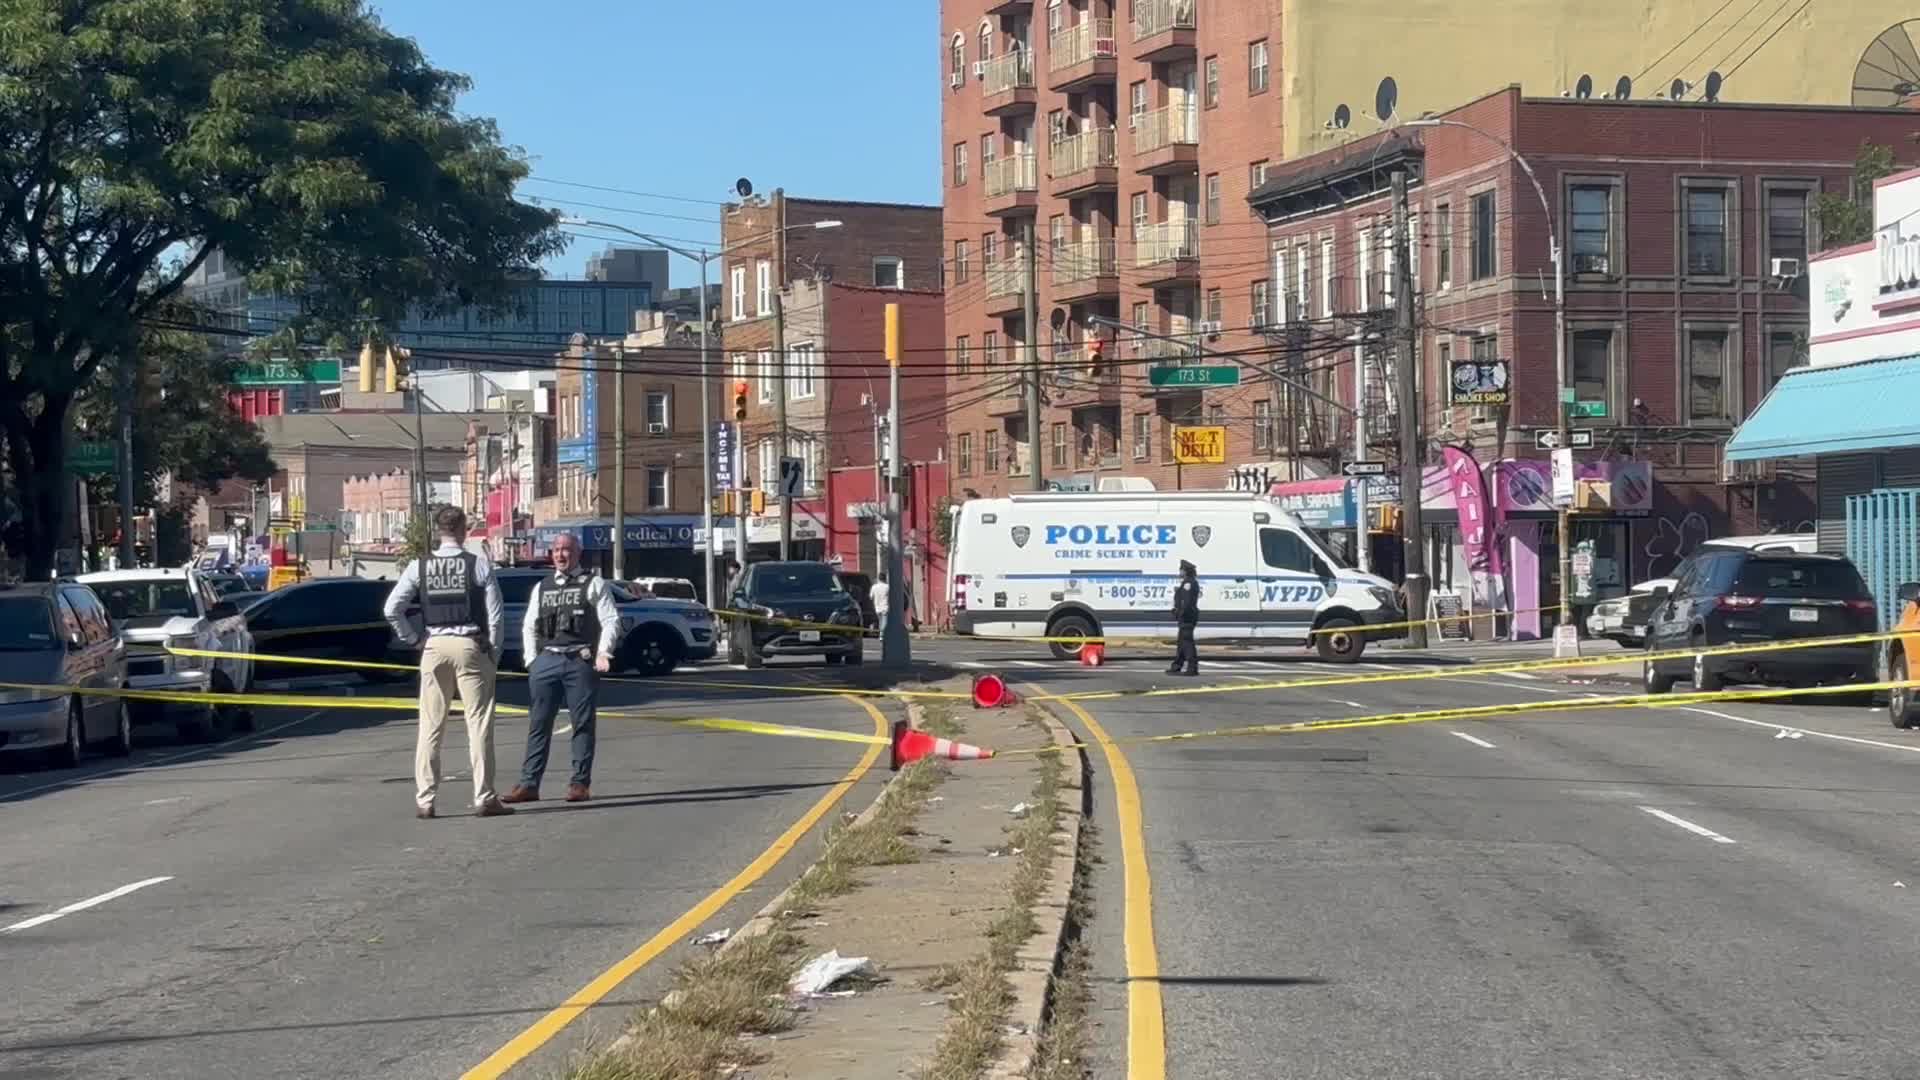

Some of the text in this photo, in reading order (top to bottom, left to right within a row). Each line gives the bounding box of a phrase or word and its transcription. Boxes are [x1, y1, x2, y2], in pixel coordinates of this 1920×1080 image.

[1179, 369, 1211, 381] 173 St
[1455, 392, 1507, 402] SMOKE SHOP
[1181, 431, 1196, 443] M
[1208, 431, 1219, 443] T
[1181, 443, 1215, 458] DELI
[1045, 525, 1177, 545] POLICE
[1055, 549, 1168, 559] CRIME SCENE UNIT
[426, 558, 466, 576] NYPD
[426, 575, 466, 589] POLICE
[1263, 585, 1323, 602] NYPD
